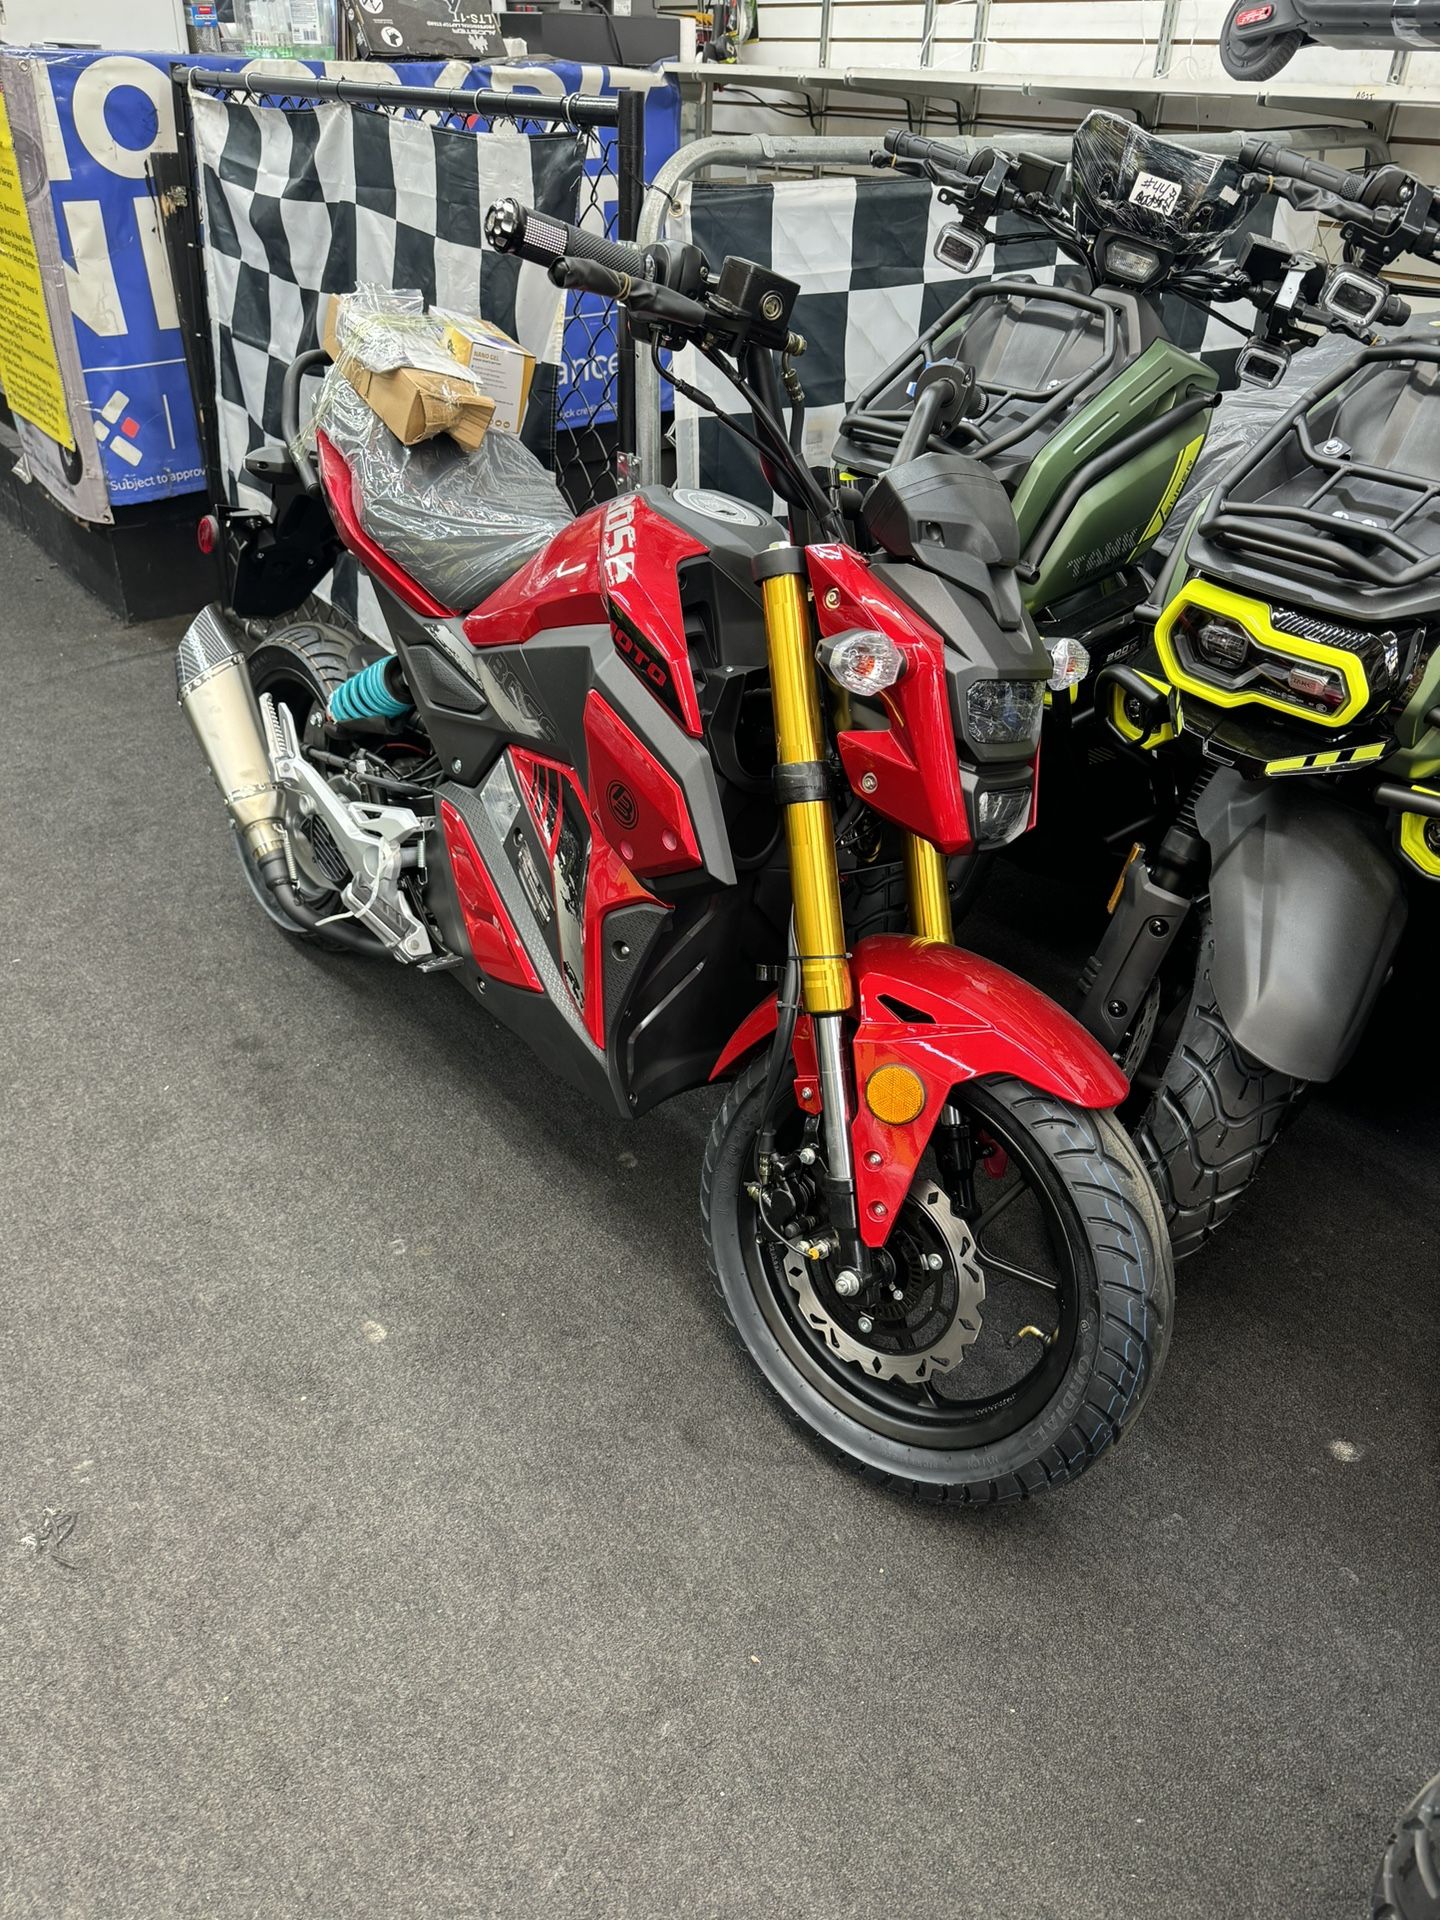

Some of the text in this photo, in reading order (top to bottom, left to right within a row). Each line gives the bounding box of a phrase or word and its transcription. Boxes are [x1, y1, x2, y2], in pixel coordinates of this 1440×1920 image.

[110, 475, 156, 491] Subject
[157, 473, 168, 484] to
[1066, 528, 1138, 578] TANK
